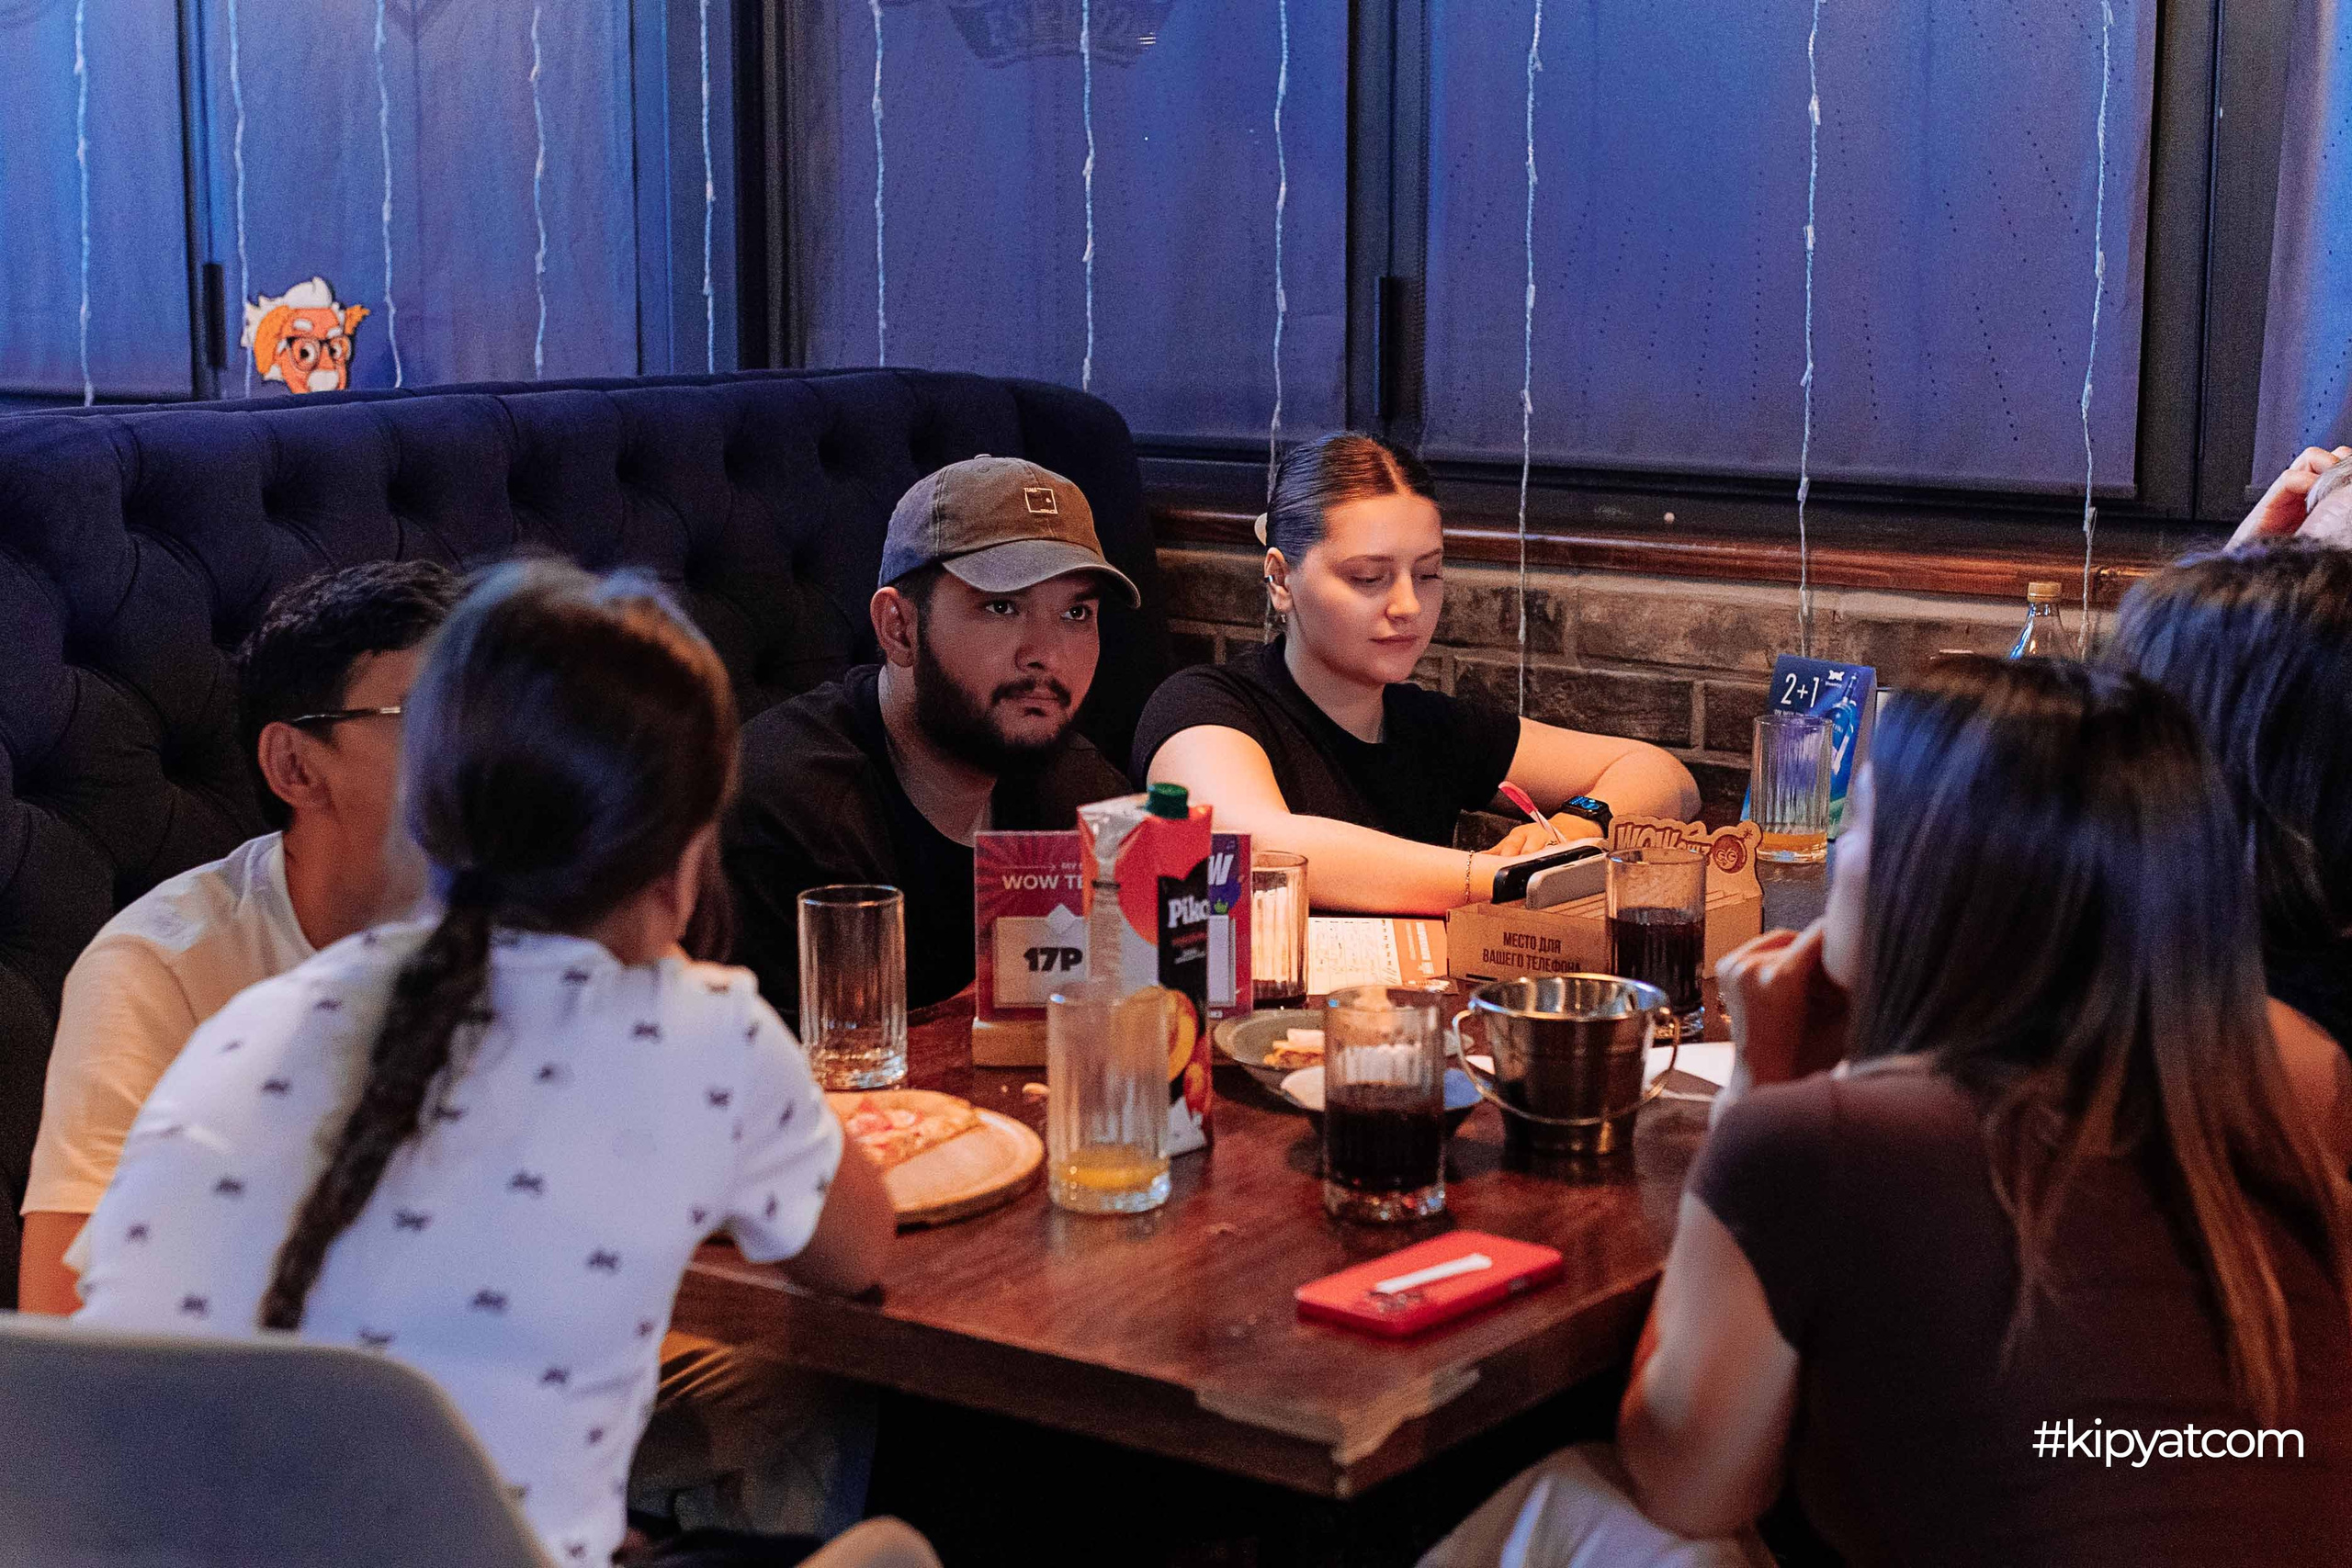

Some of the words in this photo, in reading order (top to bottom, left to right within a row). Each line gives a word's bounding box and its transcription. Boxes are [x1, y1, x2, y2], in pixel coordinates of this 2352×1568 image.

[1781, 673, 1820, 708] 2+1
[1002, 874, 1059, 890] WOW
[1503, 931, 1536, 951] МЕСТО
[1538, 936, 1562, 954] ДЛЯ
[1482, 949, 1524, 968] ВАШЕГО
[1526, 954, 1581, 973] ТЕЛЕФОНА
